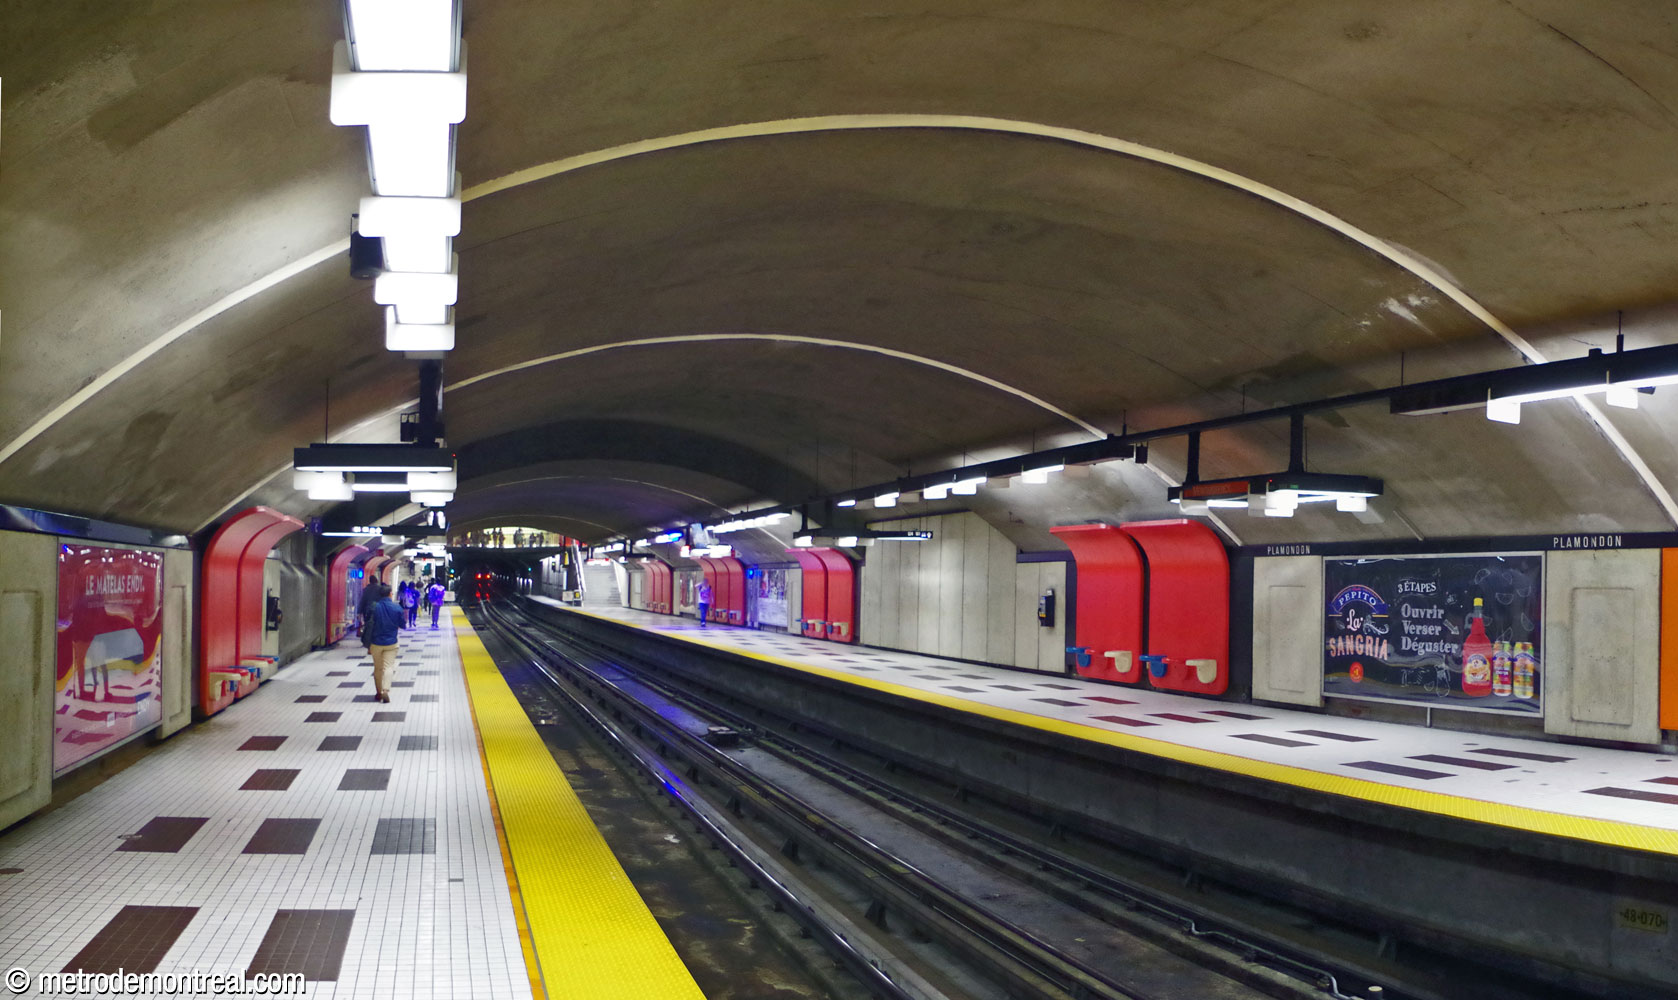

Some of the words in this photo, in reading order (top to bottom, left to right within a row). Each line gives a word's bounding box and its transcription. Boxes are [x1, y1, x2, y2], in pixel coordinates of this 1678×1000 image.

[1553, 535, 1622, 548] PLAMONDON
[1267, 545, 1311, 555] PLAMONDON
[86, 575, 94, 595] LE
[96, 574, 125, 594] MATELAS
[1398, 584, 1403, 593] 3
[1404, 581, 1437, 592] ÉTAPES
[1339, 592, 1377, 606] PEPITO
[1401, 603, 1445, 619] Ouvrir
[1347, 609, 1362, 631] La
[1402, 620, 1442, 635] Verser
[1329, 635, 1388, 660] SANGRIA
[1401, 637, 1459, 655] Déguster
